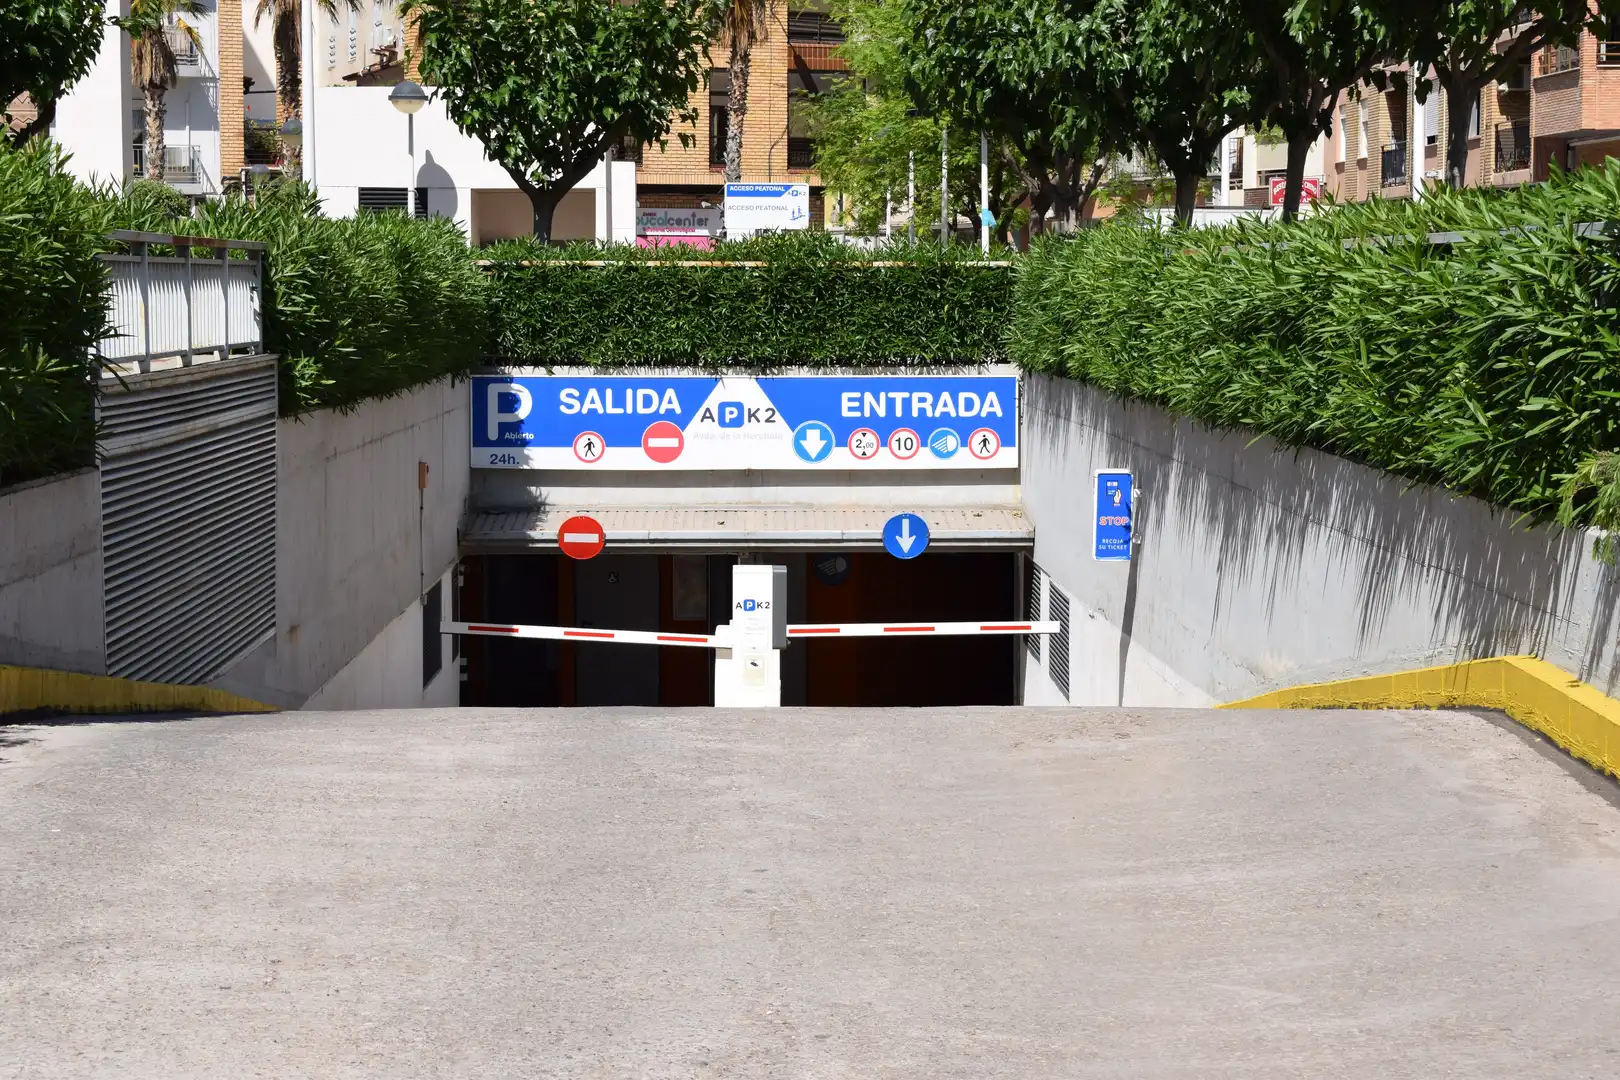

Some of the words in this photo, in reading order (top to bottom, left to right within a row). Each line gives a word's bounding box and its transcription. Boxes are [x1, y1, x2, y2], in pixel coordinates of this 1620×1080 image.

[559, 388, 682, 415] SALIDA
[841, 391, 1003, 418] ENTRADA
[487, 383, 533, 441] P
[504, 431, 534, 440] Abierto
[719, 432, 731, 440] de
[732, 432, 741, 440] la
[894, 437, 914, 451] 10
[489, 453, 520, 465] 24h.
[1099, 516, 1130, 526] STOP
[735, 600, 770, 611] APK2
